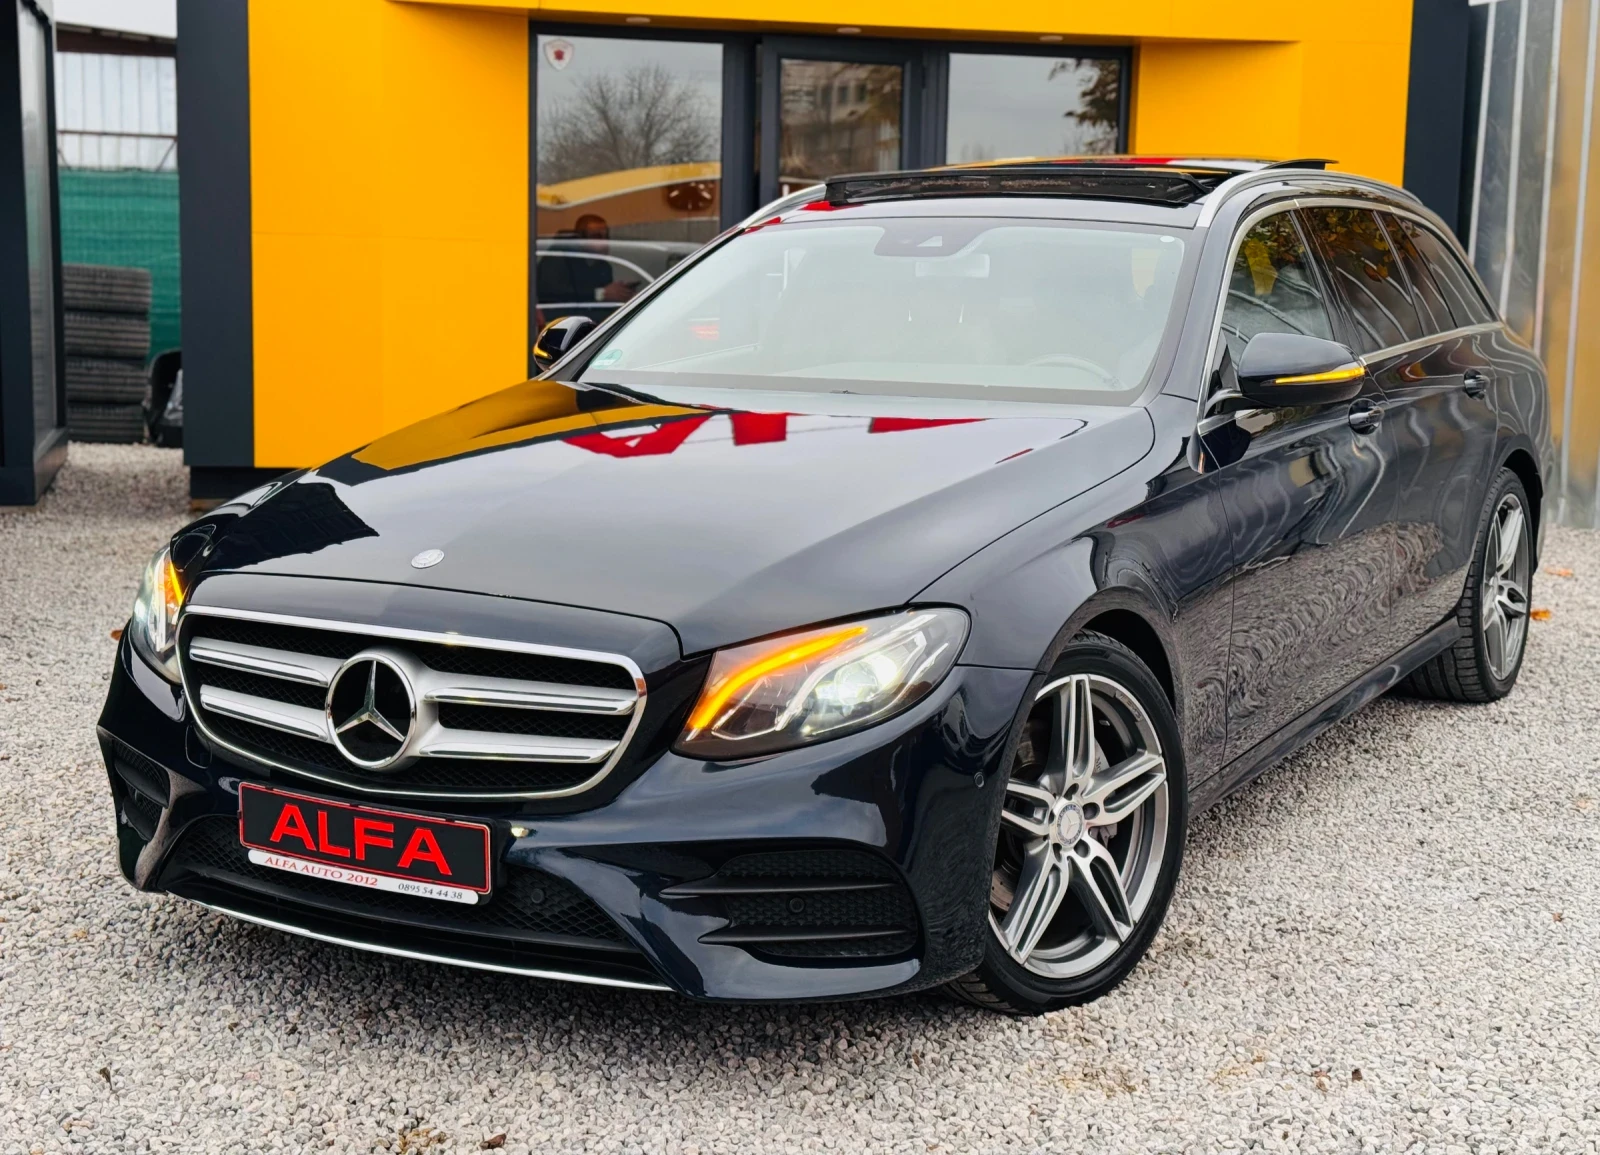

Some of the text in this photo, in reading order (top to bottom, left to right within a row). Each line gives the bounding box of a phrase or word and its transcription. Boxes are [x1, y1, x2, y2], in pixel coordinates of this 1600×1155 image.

[270, 803, 452, 876] ALFA
[264, 856, 379, 887] ALFA AUTO 2012
[398, 882, 463, 900] 0895 54 44 38
